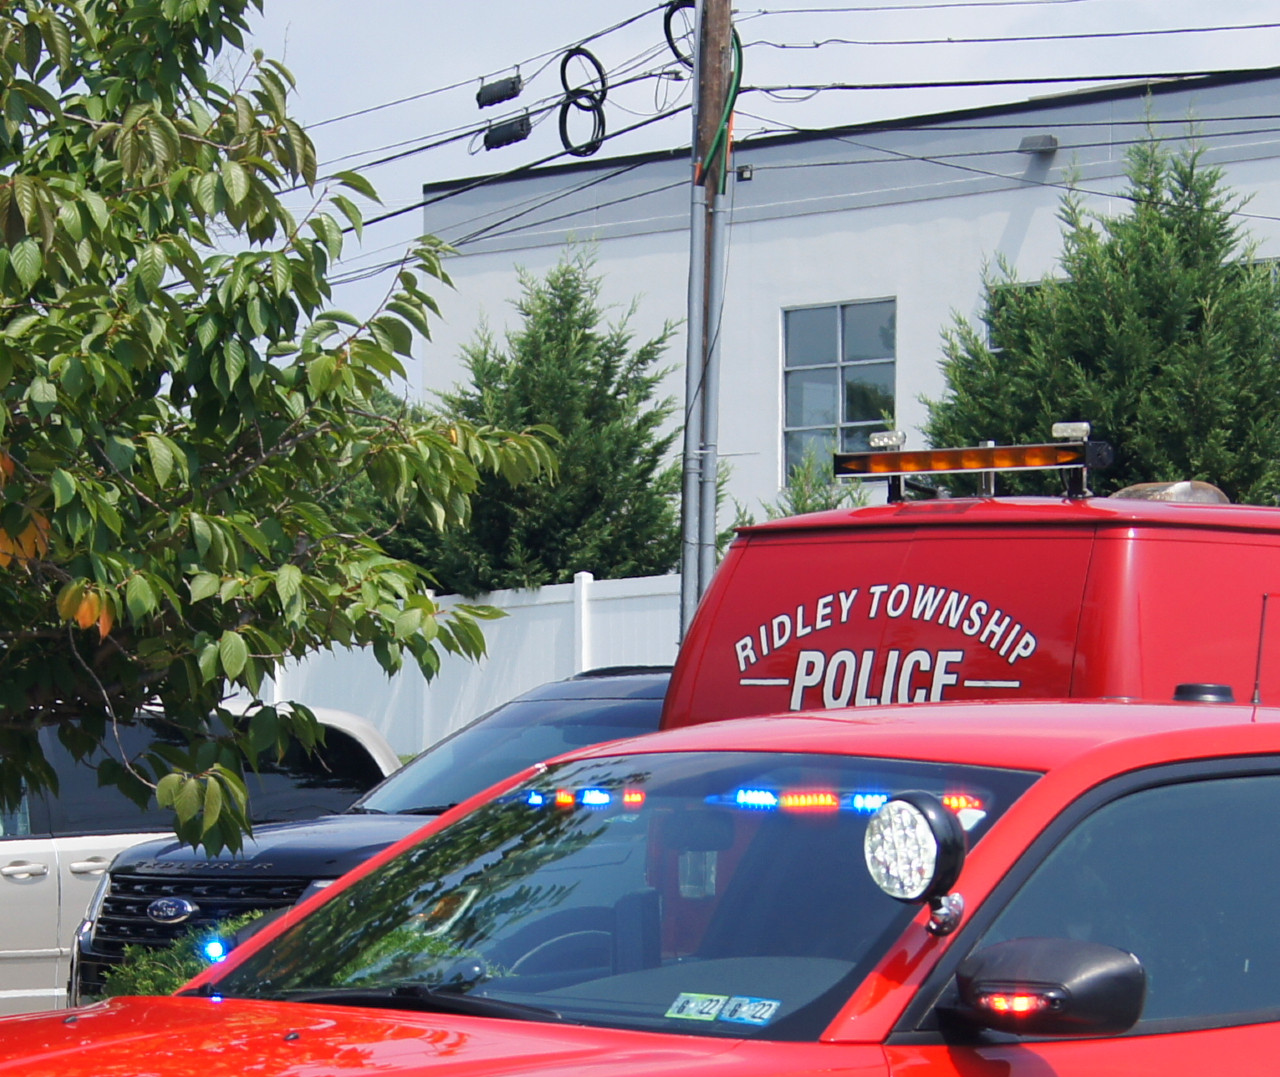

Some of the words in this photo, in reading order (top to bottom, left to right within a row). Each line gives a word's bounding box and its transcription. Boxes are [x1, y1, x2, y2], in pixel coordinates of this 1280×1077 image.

[735, 587, 860, 671] RIDLEY
[868, 583, 1037, 665] TOWNSHIP
[790, 649, 964, 711] POLICE
[699, 999, 721, 1015] 22
[751, 1003, 773, 1019] 22
